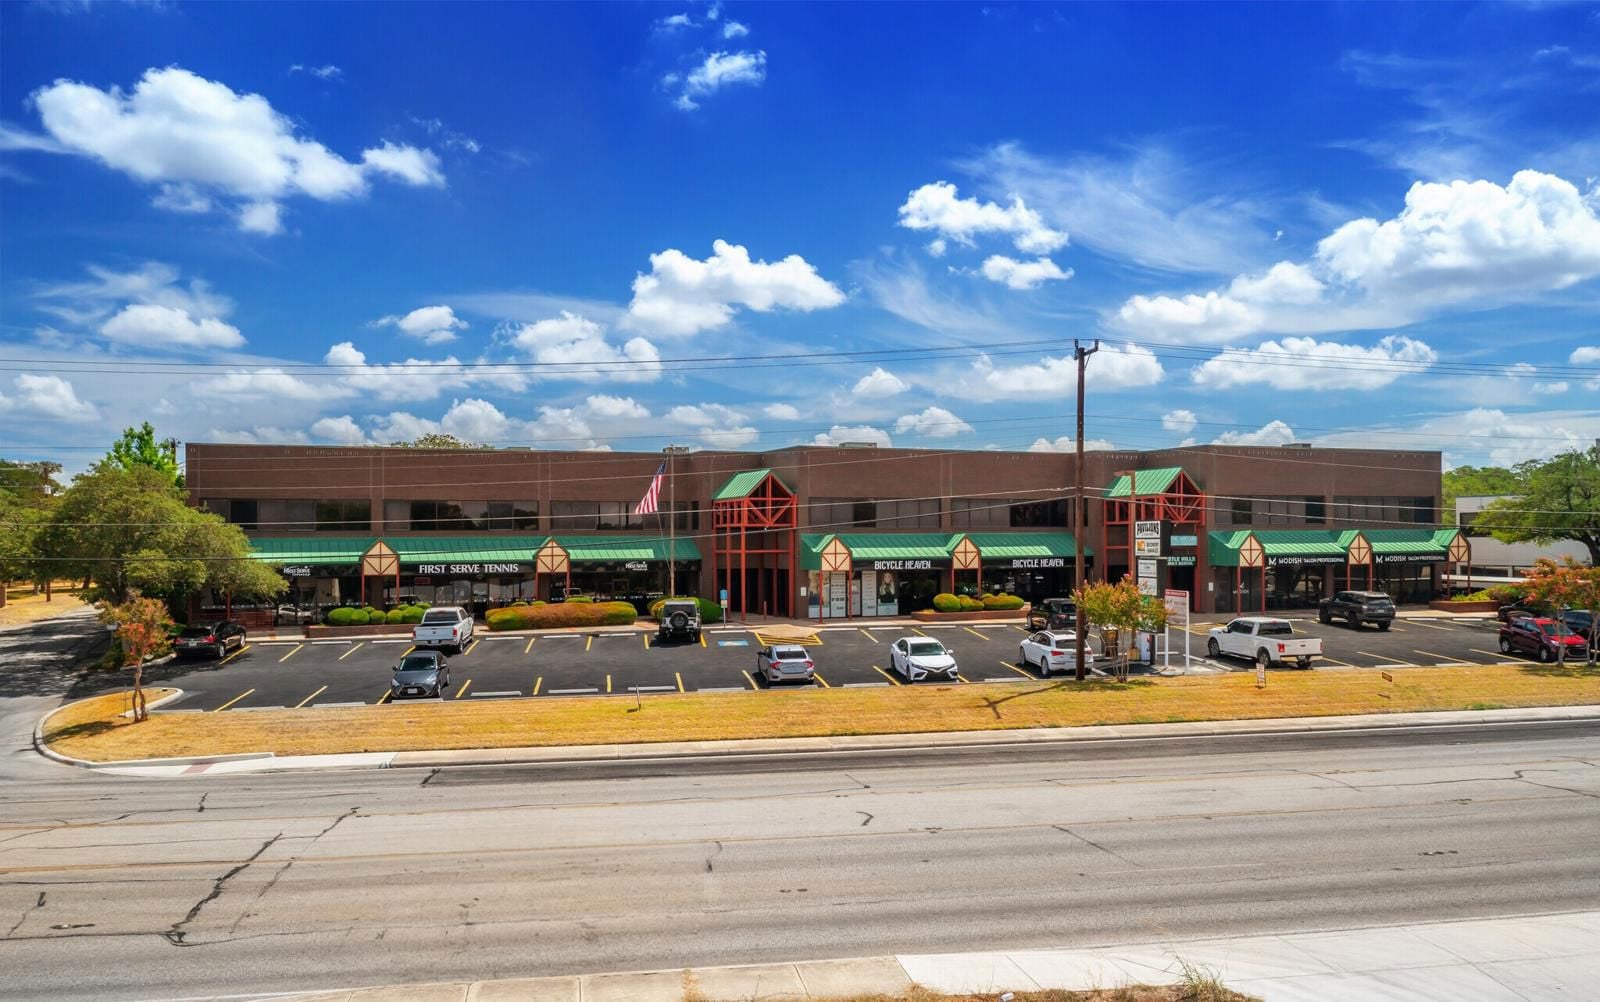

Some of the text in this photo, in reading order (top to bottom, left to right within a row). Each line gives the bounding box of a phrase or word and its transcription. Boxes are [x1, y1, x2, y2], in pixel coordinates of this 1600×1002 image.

[1137, 522, 1159, 536] PAVILIONS
[419, 563, 519, 574] FIRST SERVE TENNIS
[874, 559, 931, 570] BICYCLE HEAVEN
[1012, 558, 1064, 568] BICYCLE HEAVEN
